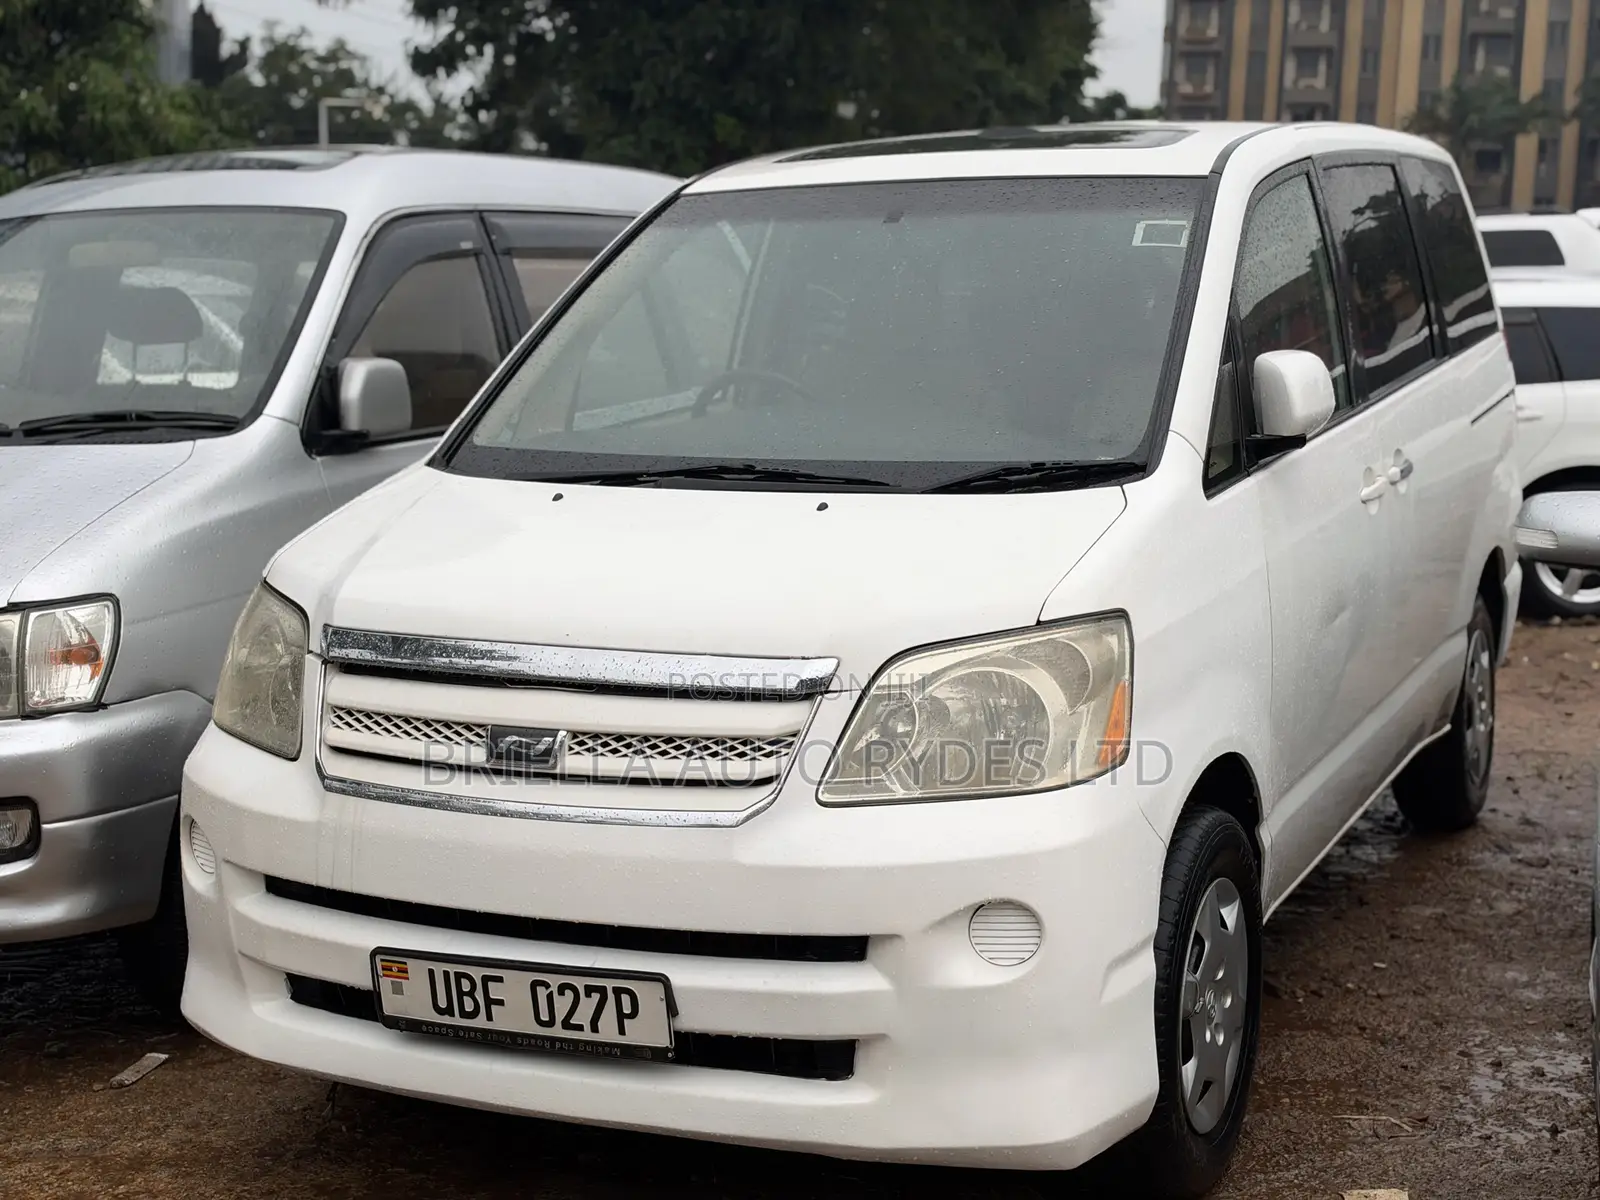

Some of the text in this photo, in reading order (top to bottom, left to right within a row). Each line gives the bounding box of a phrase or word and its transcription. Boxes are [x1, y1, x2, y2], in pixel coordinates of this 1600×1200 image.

[428, 967, 640, 1036] UBF 027P
[421, 1024, 454, 1037] Space
[458, 1030, 482, 1040] Safe
[486, 1033, 512, 1044] Your
[517, 1037, 551, 1049] Roads
[579, 1042, 620, 1056] Making
